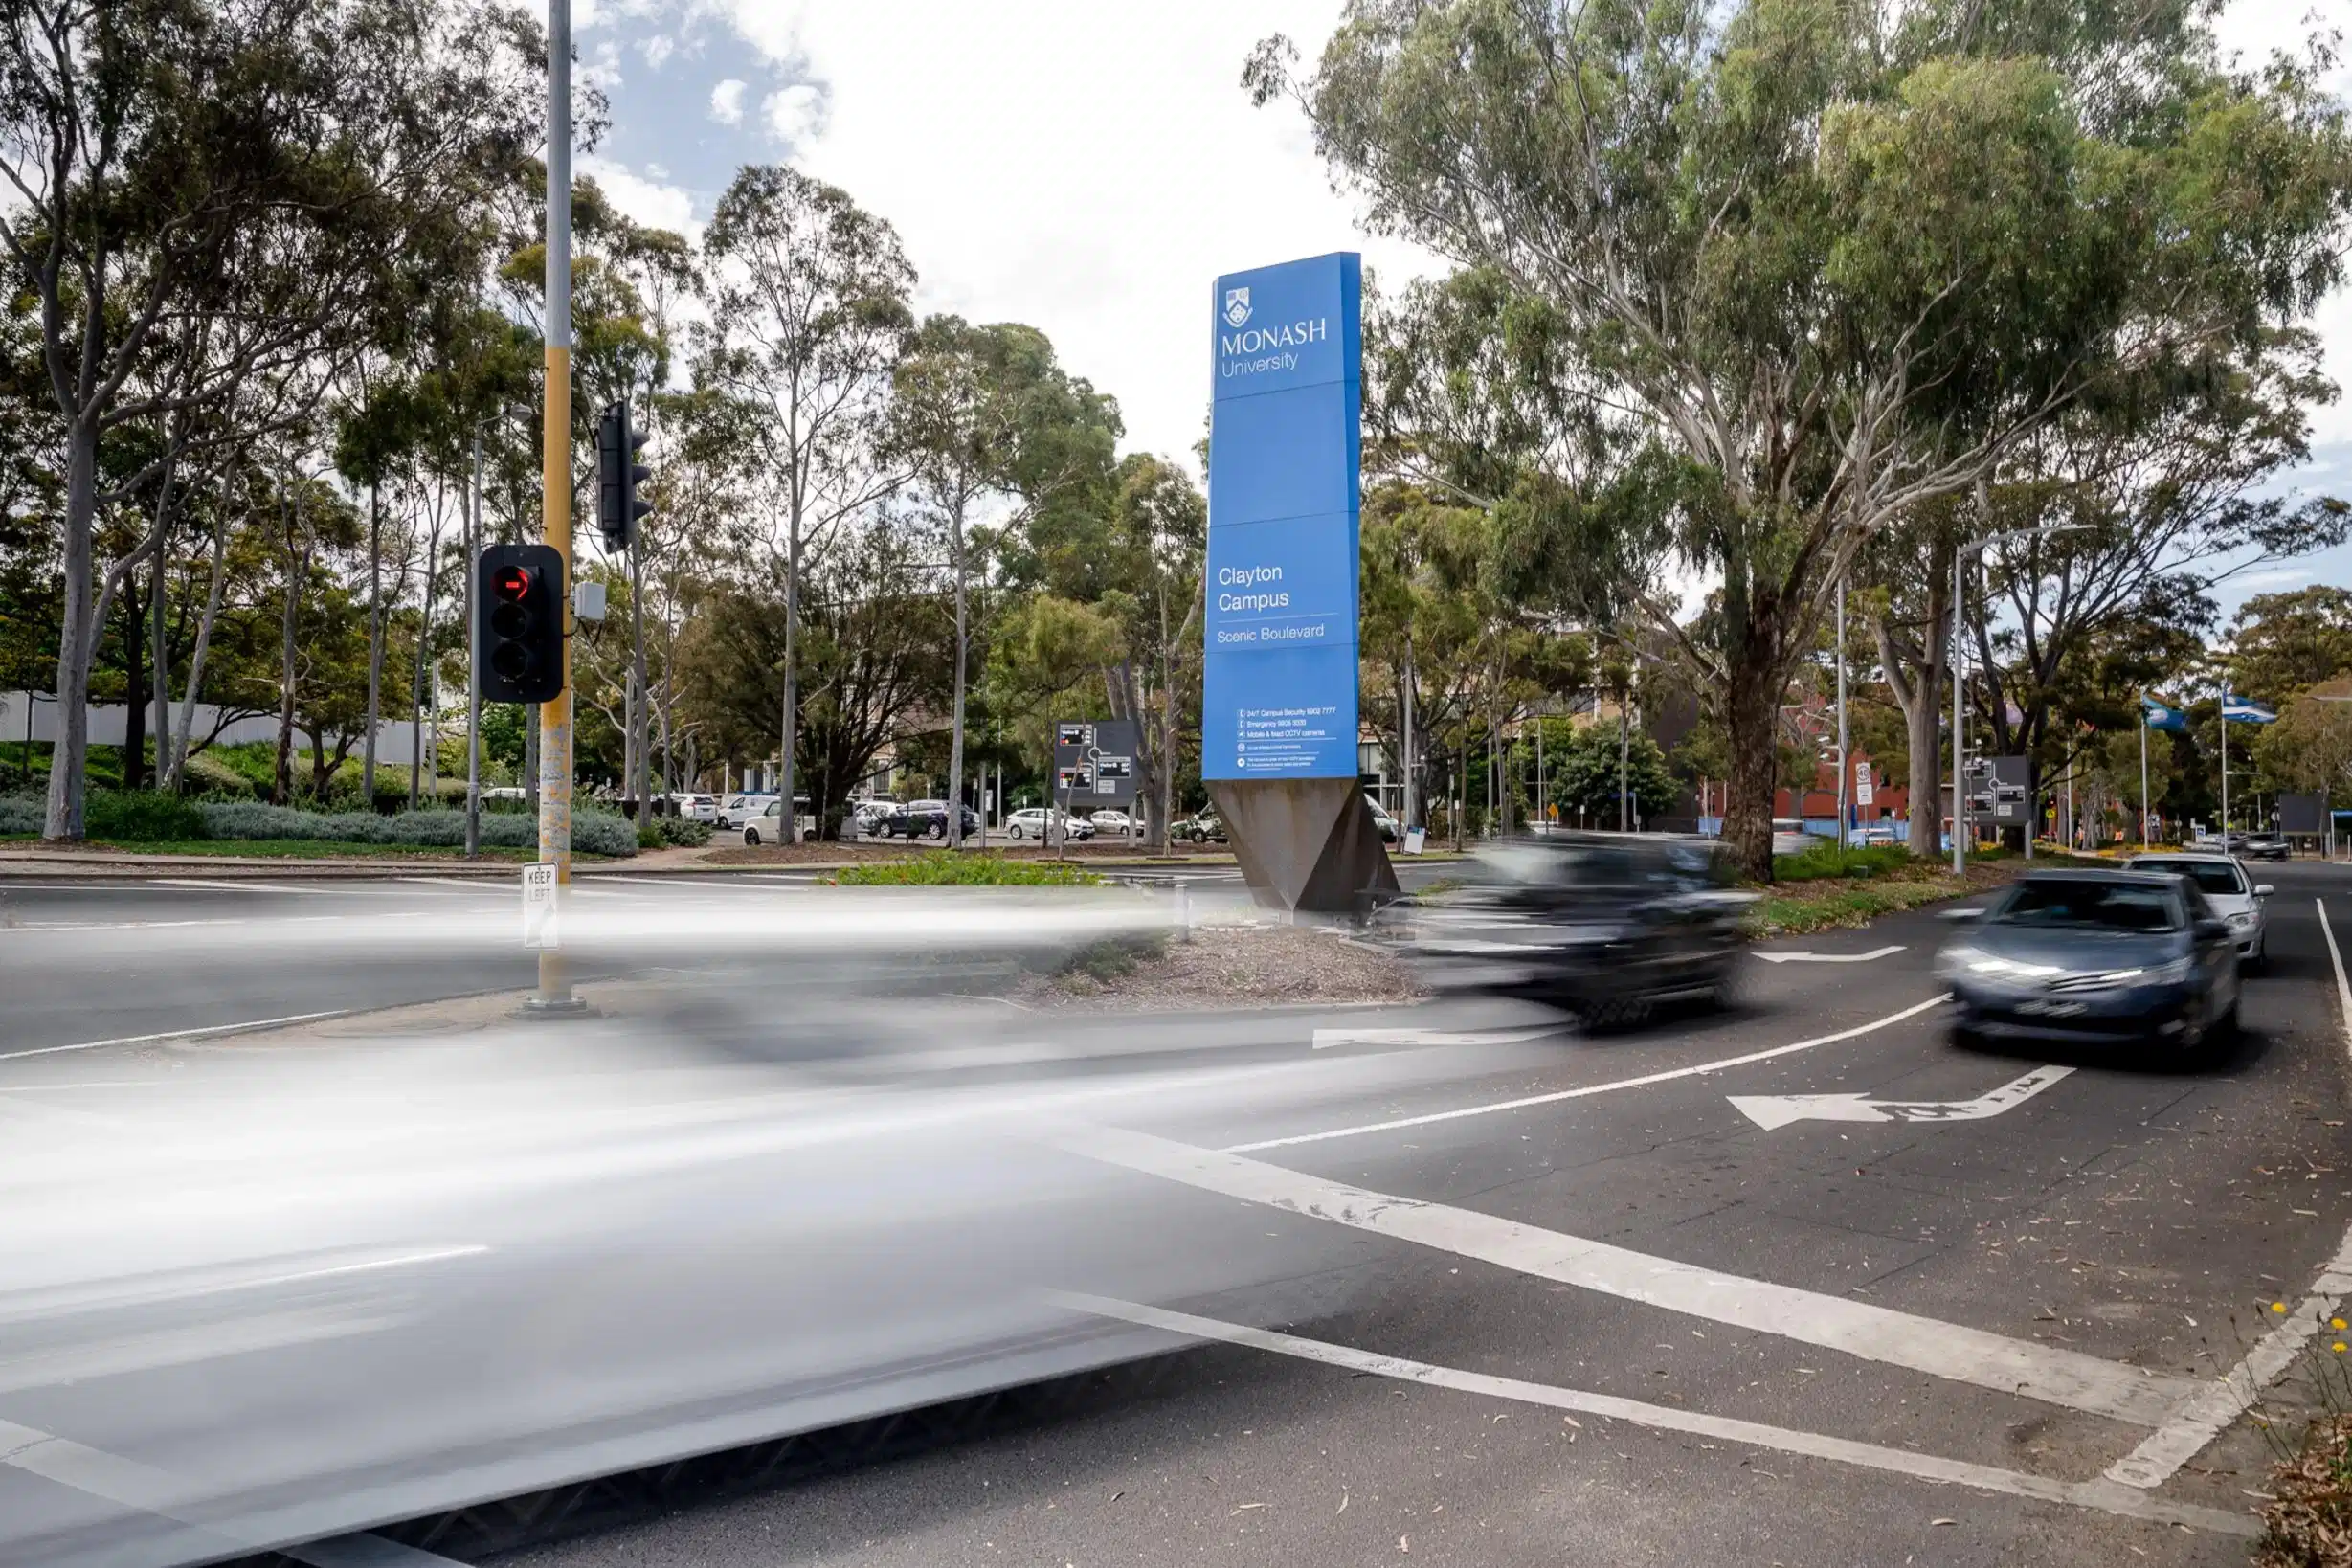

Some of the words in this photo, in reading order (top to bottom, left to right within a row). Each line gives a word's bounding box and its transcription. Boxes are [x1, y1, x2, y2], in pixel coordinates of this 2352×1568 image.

[1222, 318, 1325, 357] MONASH
[1221, 351, 1299, 378] University
[1219, 565, 1283, 587] Clayton
[1219, 592, 1289, 613] Campus
[1217, 629, 1257, 644] Scenic
[1261, 623, 1325, 641] Boulevard
[528, 870, 551, 885] KEEP
[529, 888, 550, 902] LEFT
